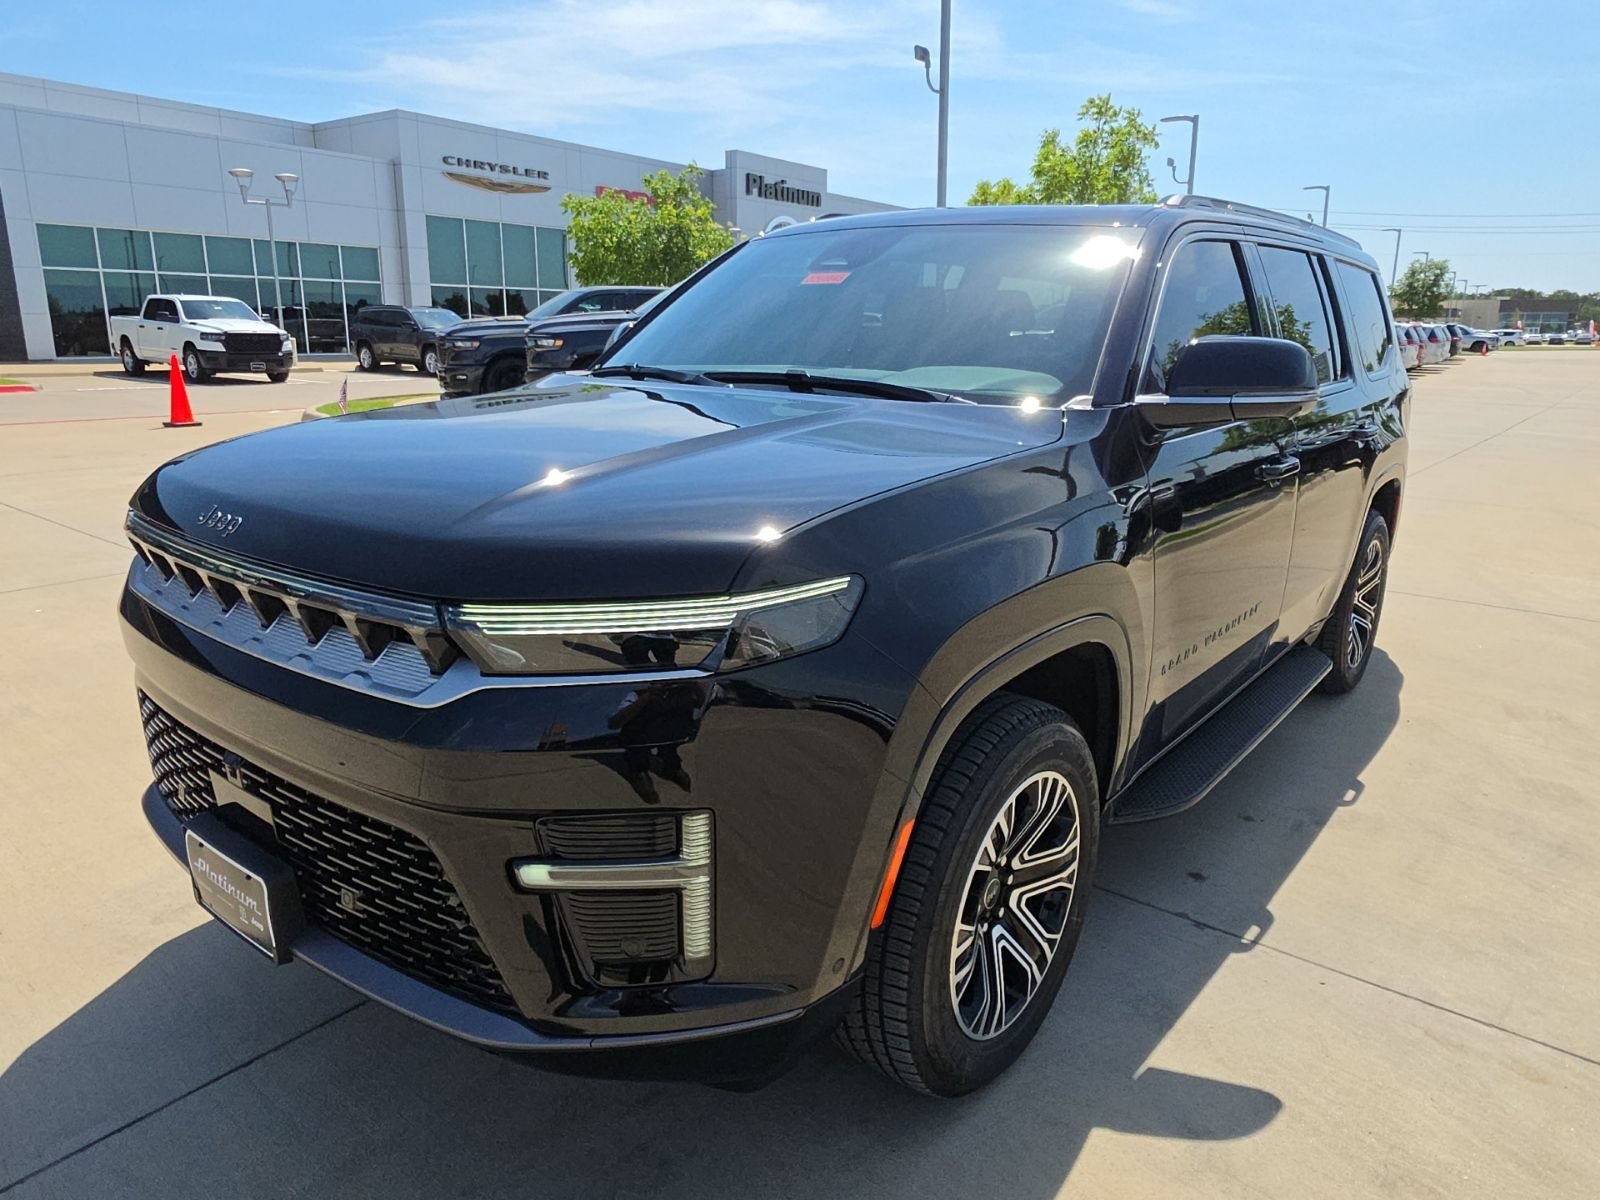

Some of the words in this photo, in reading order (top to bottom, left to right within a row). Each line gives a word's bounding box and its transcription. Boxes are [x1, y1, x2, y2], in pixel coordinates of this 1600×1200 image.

[442, 155, 549, 180] CHRYSLER
[745, 173, 821, 208] Platinum
[197, 504, 243, 537] Jeep
[193, 857, 262, 916] Platinum
